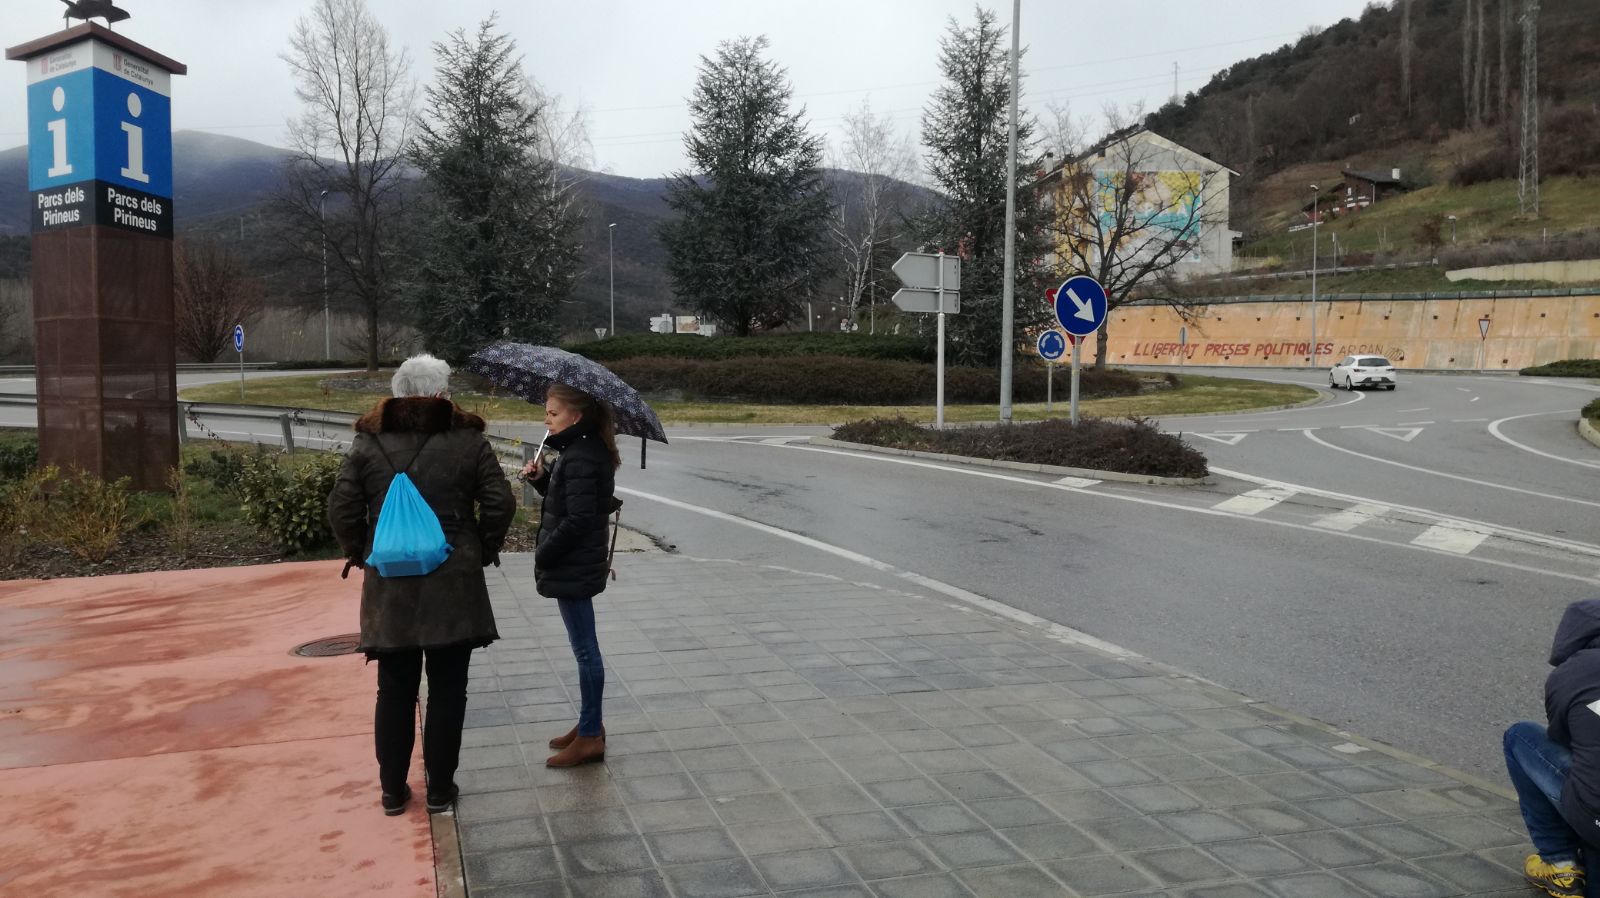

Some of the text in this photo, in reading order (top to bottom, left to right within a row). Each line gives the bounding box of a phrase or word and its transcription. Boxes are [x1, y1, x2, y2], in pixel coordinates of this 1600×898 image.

[124, 58, 149, 75] Generalitat
[130, 70, 154, 86] Catalunya
[38, 187, 85, 208] Parcs dels
[107, 187, 162, 215] Parcs dels
[43, 209, 80, 226] Pirineus
[114, 207, 157, 231] Pirineus
[1133, 343, 1199, 356] LLIBERTAT
[1204, 343, 1251, 356] PRESES
[1254, 342, 1334, 356] POLITIQUES
